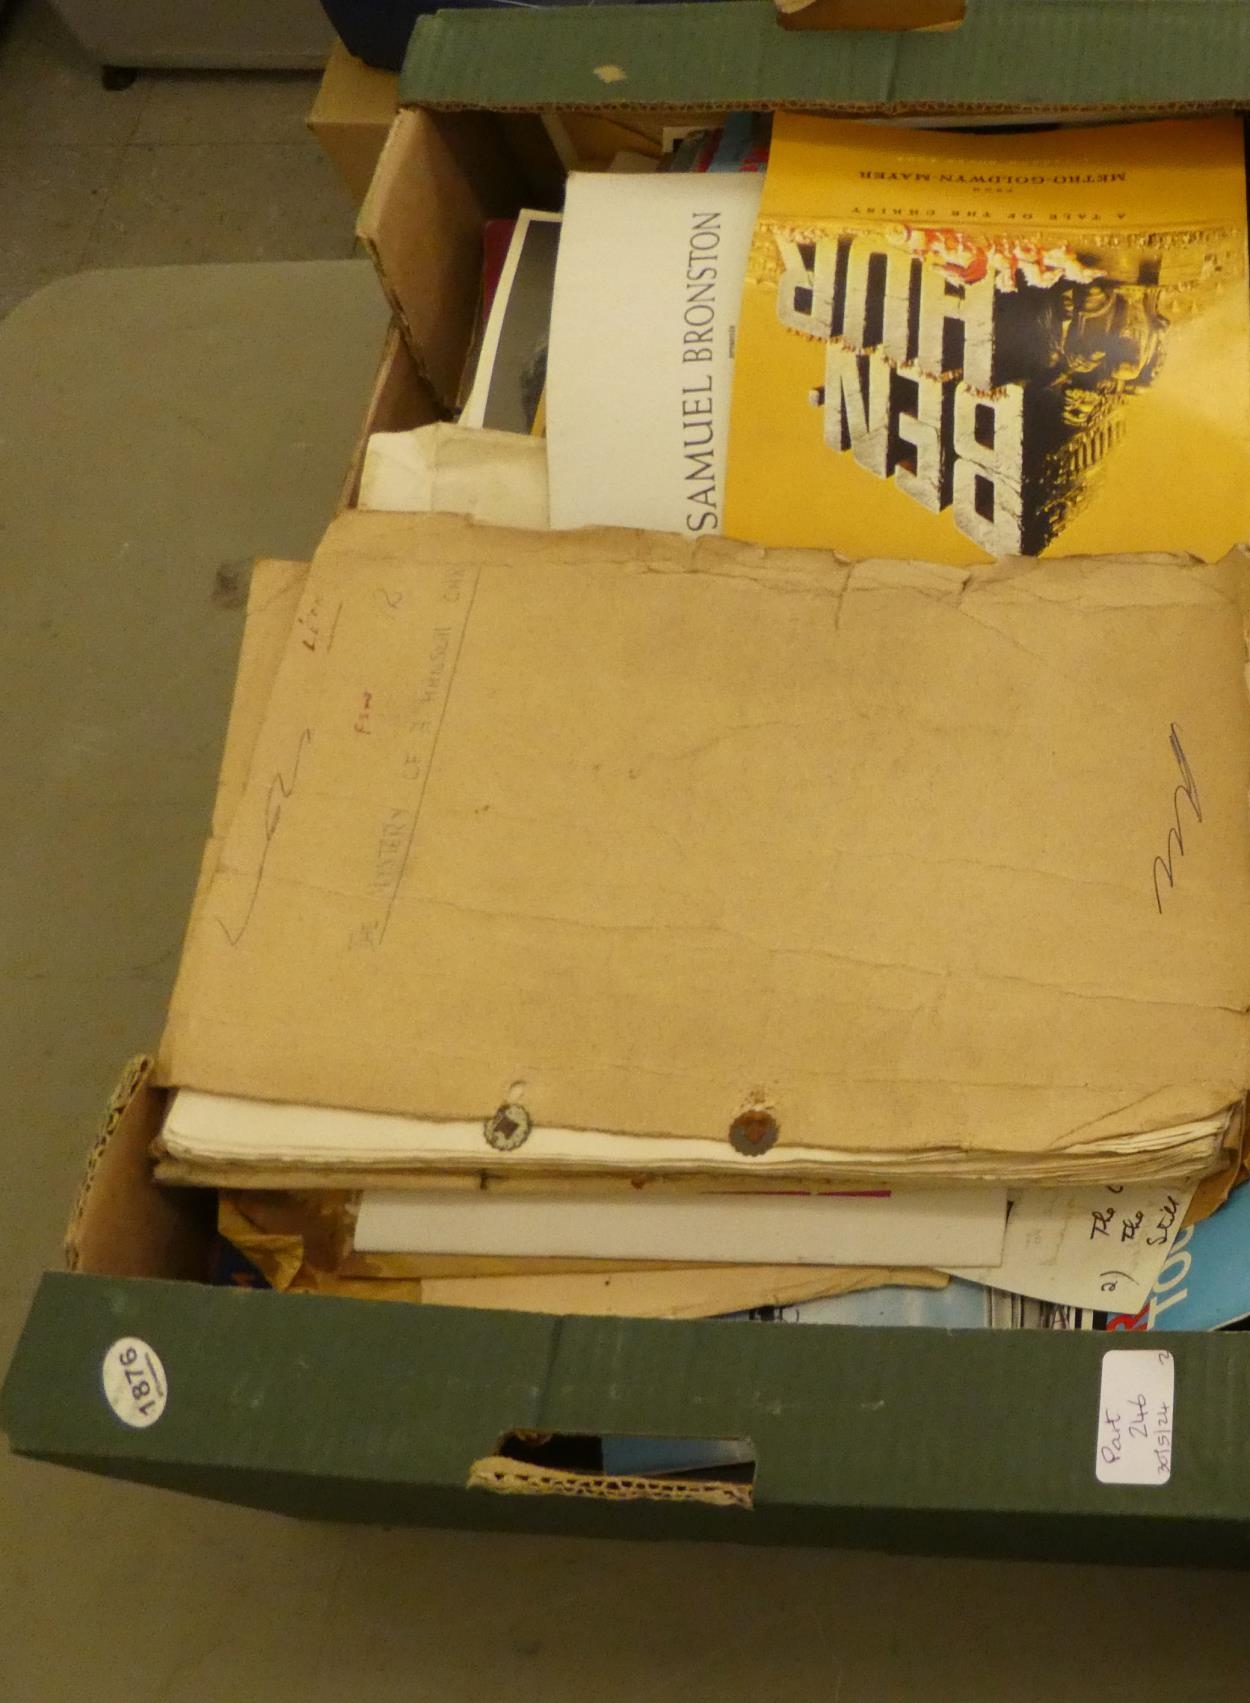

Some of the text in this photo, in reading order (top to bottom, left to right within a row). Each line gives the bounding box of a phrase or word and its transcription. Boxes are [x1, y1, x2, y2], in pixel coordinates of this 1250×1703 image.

[852, 207, 936, 216] CHRIST
[774, 234, 996, 388] HUR
[682, 212, 722, 531] SAMUEL BRONSTON
[1090, 1207, 1115, 1239] The
[1121, 1210, 1144, 1242] The
[119, 1347, 155, 1416] 1876
[1101, 1409, 1121, 1464] Part
[1128, 1393, 1147, 1438] 246
